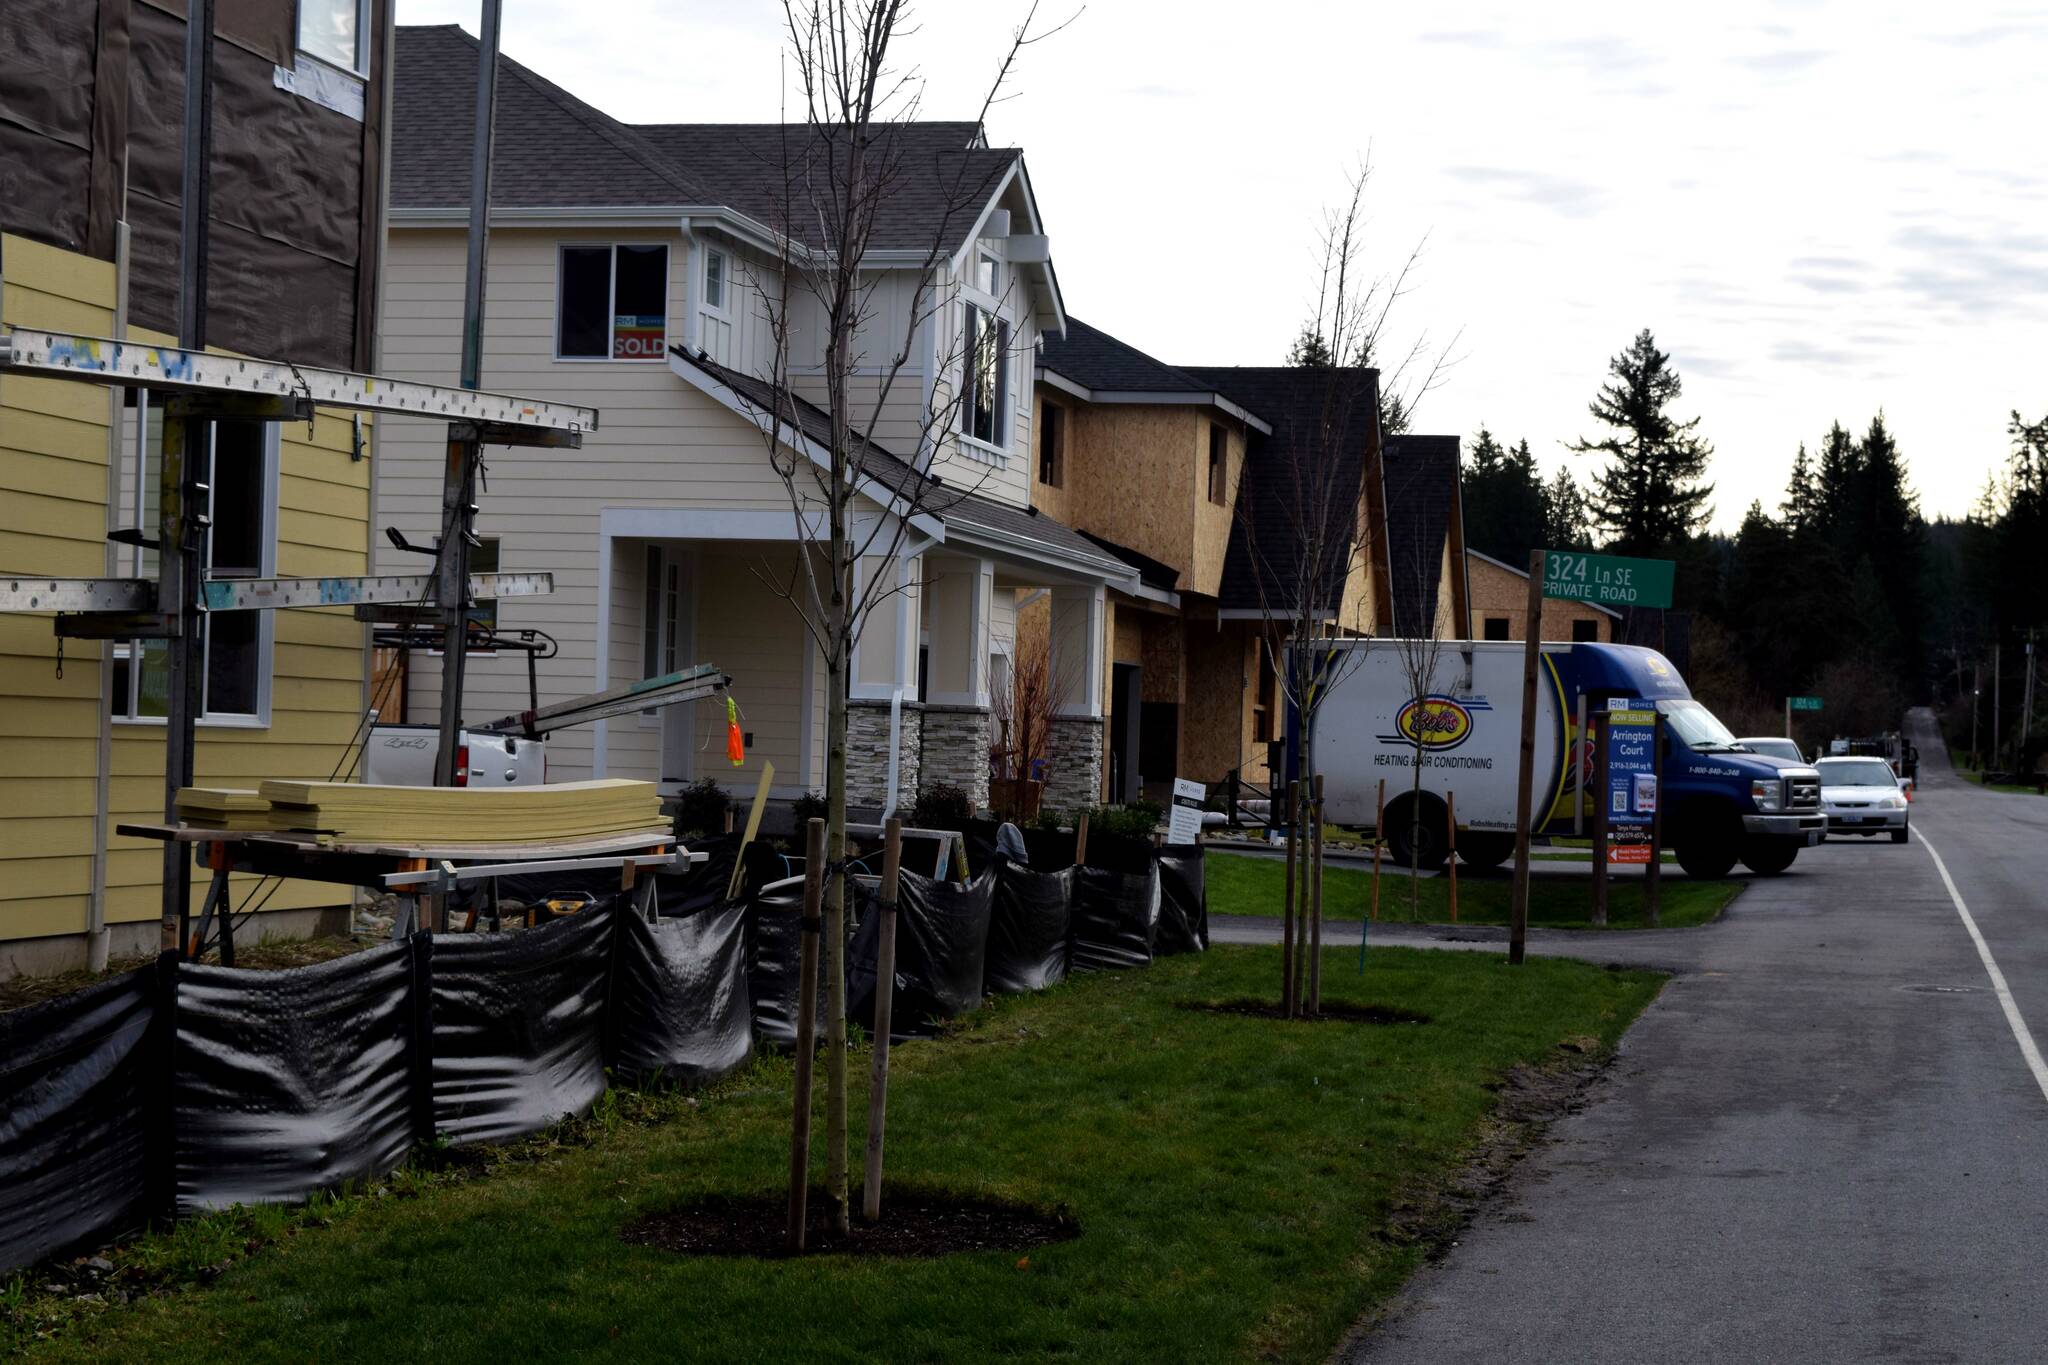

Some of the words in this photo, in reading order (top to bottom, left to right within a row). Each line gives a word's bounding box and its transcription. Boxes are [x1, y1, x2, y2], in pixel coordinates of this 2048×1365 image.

[614, 337, 665, 355] SOLD
[1548, 554, 1587, 582] 324
[1595, 566, 1611, 584] Ln
[1615, 568, 1633, 586] SE
[1543, 580, 1593, 598] PRIVATE
[1600, 586, 1637, 602] ROAD
[1610, 699, 1626, 709] RM
[1410, 710, 1460, 734] Bob's
[1610, 713, 1627, 721] NOW
[1628, 713, 1654, 722] SELLING
[384, 737, 430, 749] 4x4
[1611, 730, 1652, 743] Arrington
[1619, 744, 1644, 756] Court
[1374, 754, 1409, 767] HEATING
[1434, 756, 1493, 769] CONDITIONING
